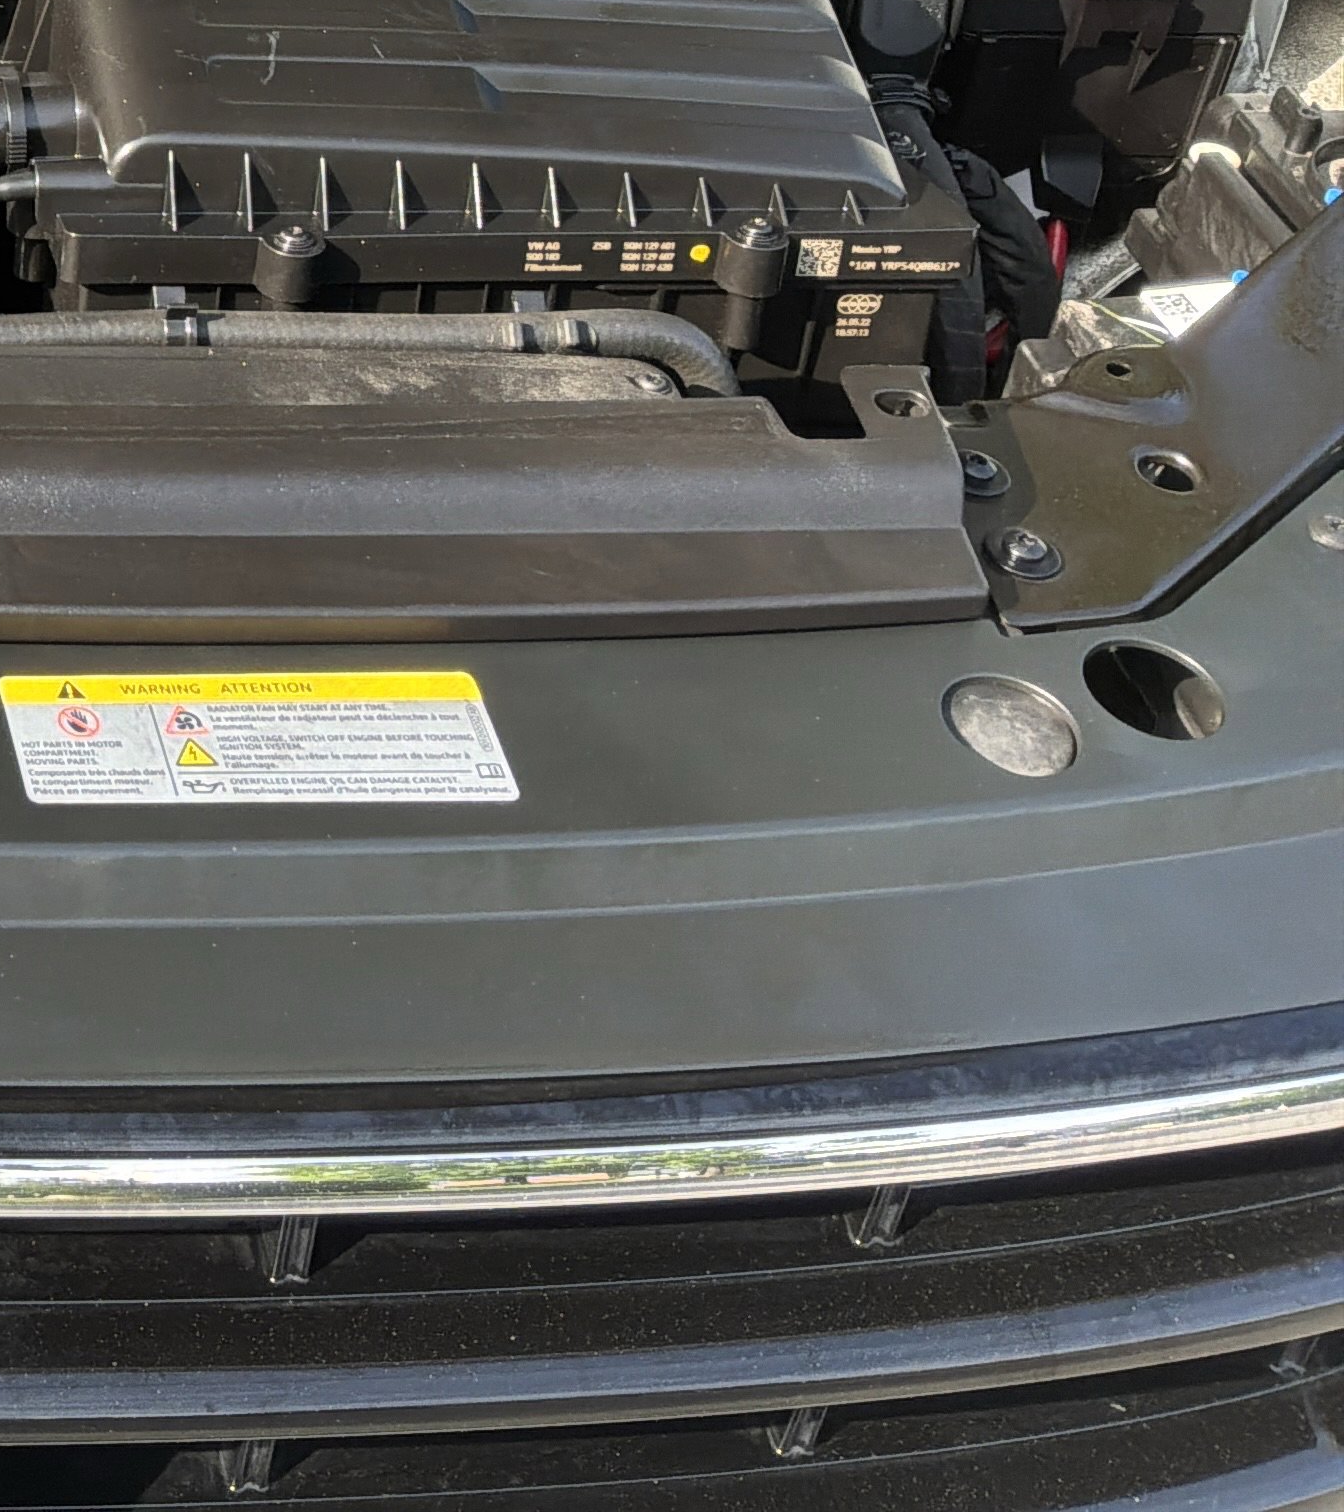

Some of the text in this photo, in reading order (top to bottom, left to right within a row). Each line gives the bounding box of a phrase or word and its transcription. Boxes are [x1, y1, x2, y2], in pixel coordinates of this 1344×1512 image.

[119, 682, 313, 695] WARNING ATTENTION
[207, 704, 255, 712] RADIATOR
[256, 704, 276, 712] FAN
[277, 704, 298, 712] MAY
[299, 704, 328, 712] START
[330, 704, 342, 712] AT
[344, 703, 363, 711] ANY
[223, 714, 276, 723] ventilateur
[278, 714, 291, 722] de
[293, 714, 338, 724] radiateur
[376, 713, 428, 721] déclencher
[439, 713, 460, 721] tout
[289, 734, 326, 742] SWITCH
[328, 734, 346, 742] OFF
[23, 749, 99, 757] COMPARTMENT.
[222, 753, 253, 761] Haute
[343, 752, 378, 760] moteur
[412, 752, 423, 760] de
[424, 752, 462, 760] toucher
[28, 768, 166, 777] Composants très chauds dans
[42, 778, 113, 787] compartiment
[230, 777, 290, 785] OVERFILLED
[291, 777, 328, 785] ENGINE
[33, 787, 65, 795] Pièces
[232, 787, 295, 796] Remplissage
[297, 786, 335, 795] excessif
[336, 786, 369, 795] d'huile
[371, 786, 423, 796] dangereux
[424, 787, 447, 795] pour
[448, 786, 458, 794] le
